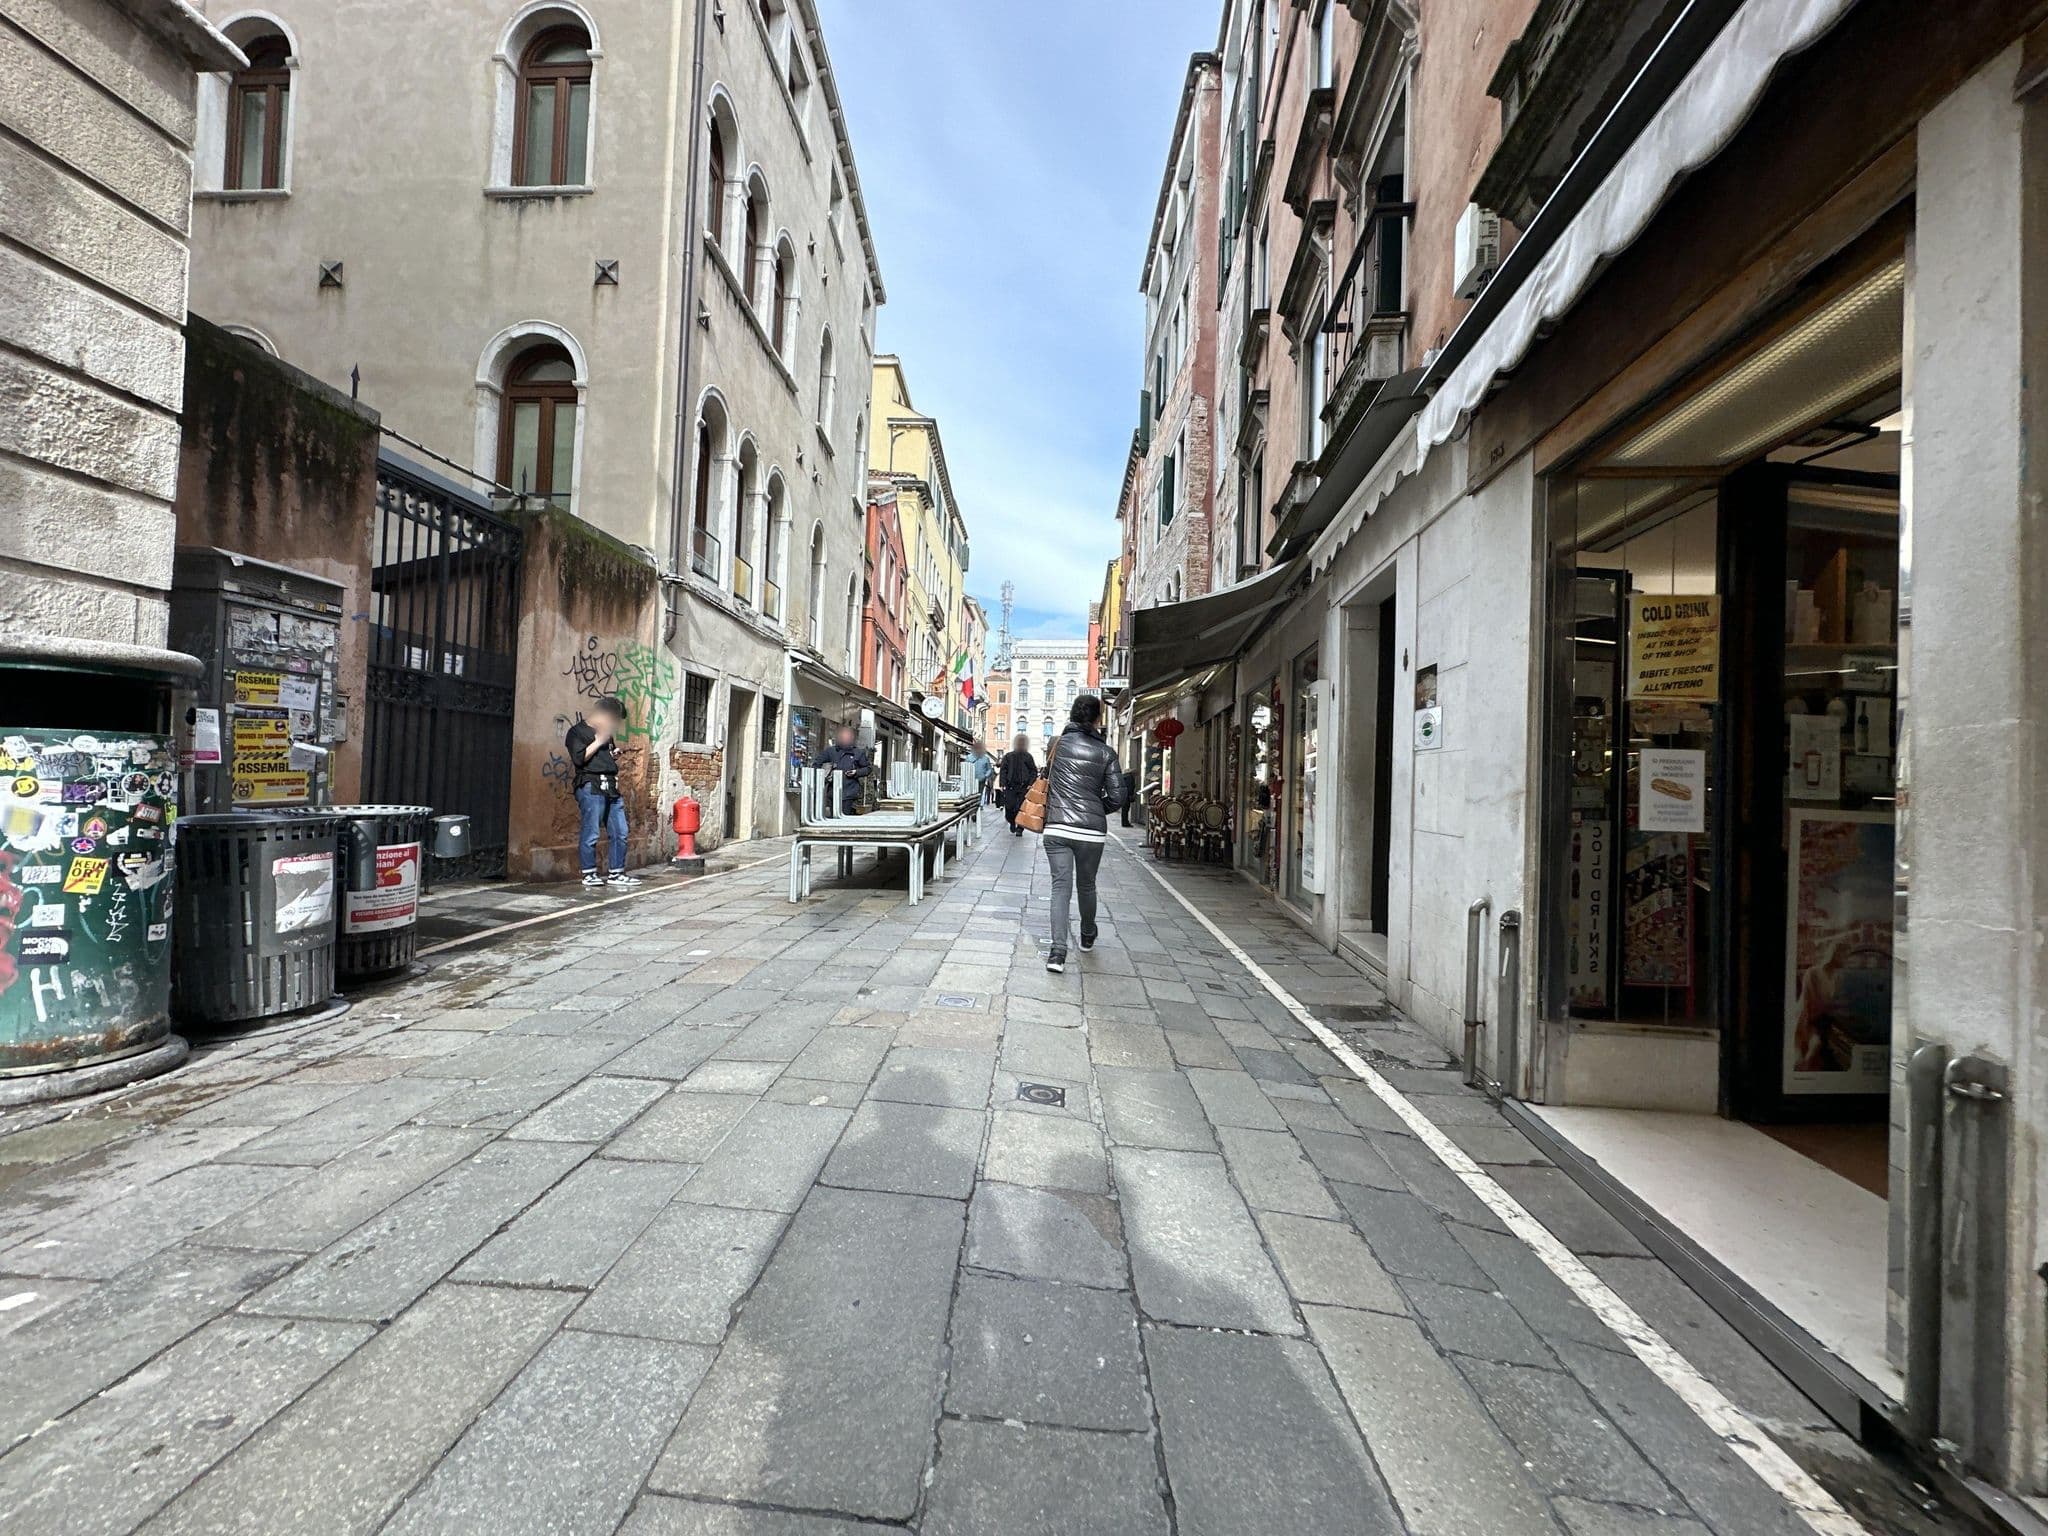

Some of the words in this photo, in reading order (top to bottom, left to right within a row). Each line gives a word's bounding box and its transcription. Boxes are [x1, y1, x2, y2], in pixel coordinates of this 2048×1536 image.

[1642, 605, 1671, 622] COLD
[1675, 602, 1710, 619] DRINK
[1646, 641, 1657, 649] AT
[1660, 640, 1675, 648] THE
[1677, 638, 1700, 647] BACK
[1642, 652, 1654, 660] OF
[1673, 649, 1697, 657] SHOP
[1639, 668, 1670, 679] BIBITE
[1672, 664, 1714, 676] FRESCHE
[1643, 679, 1703, 693] ALL'INTERNO
[238, 762, 305, 774] ASSEMBL
[75, 860, 106, 869] KEIN
[71, 867, 103, 878] ORT
